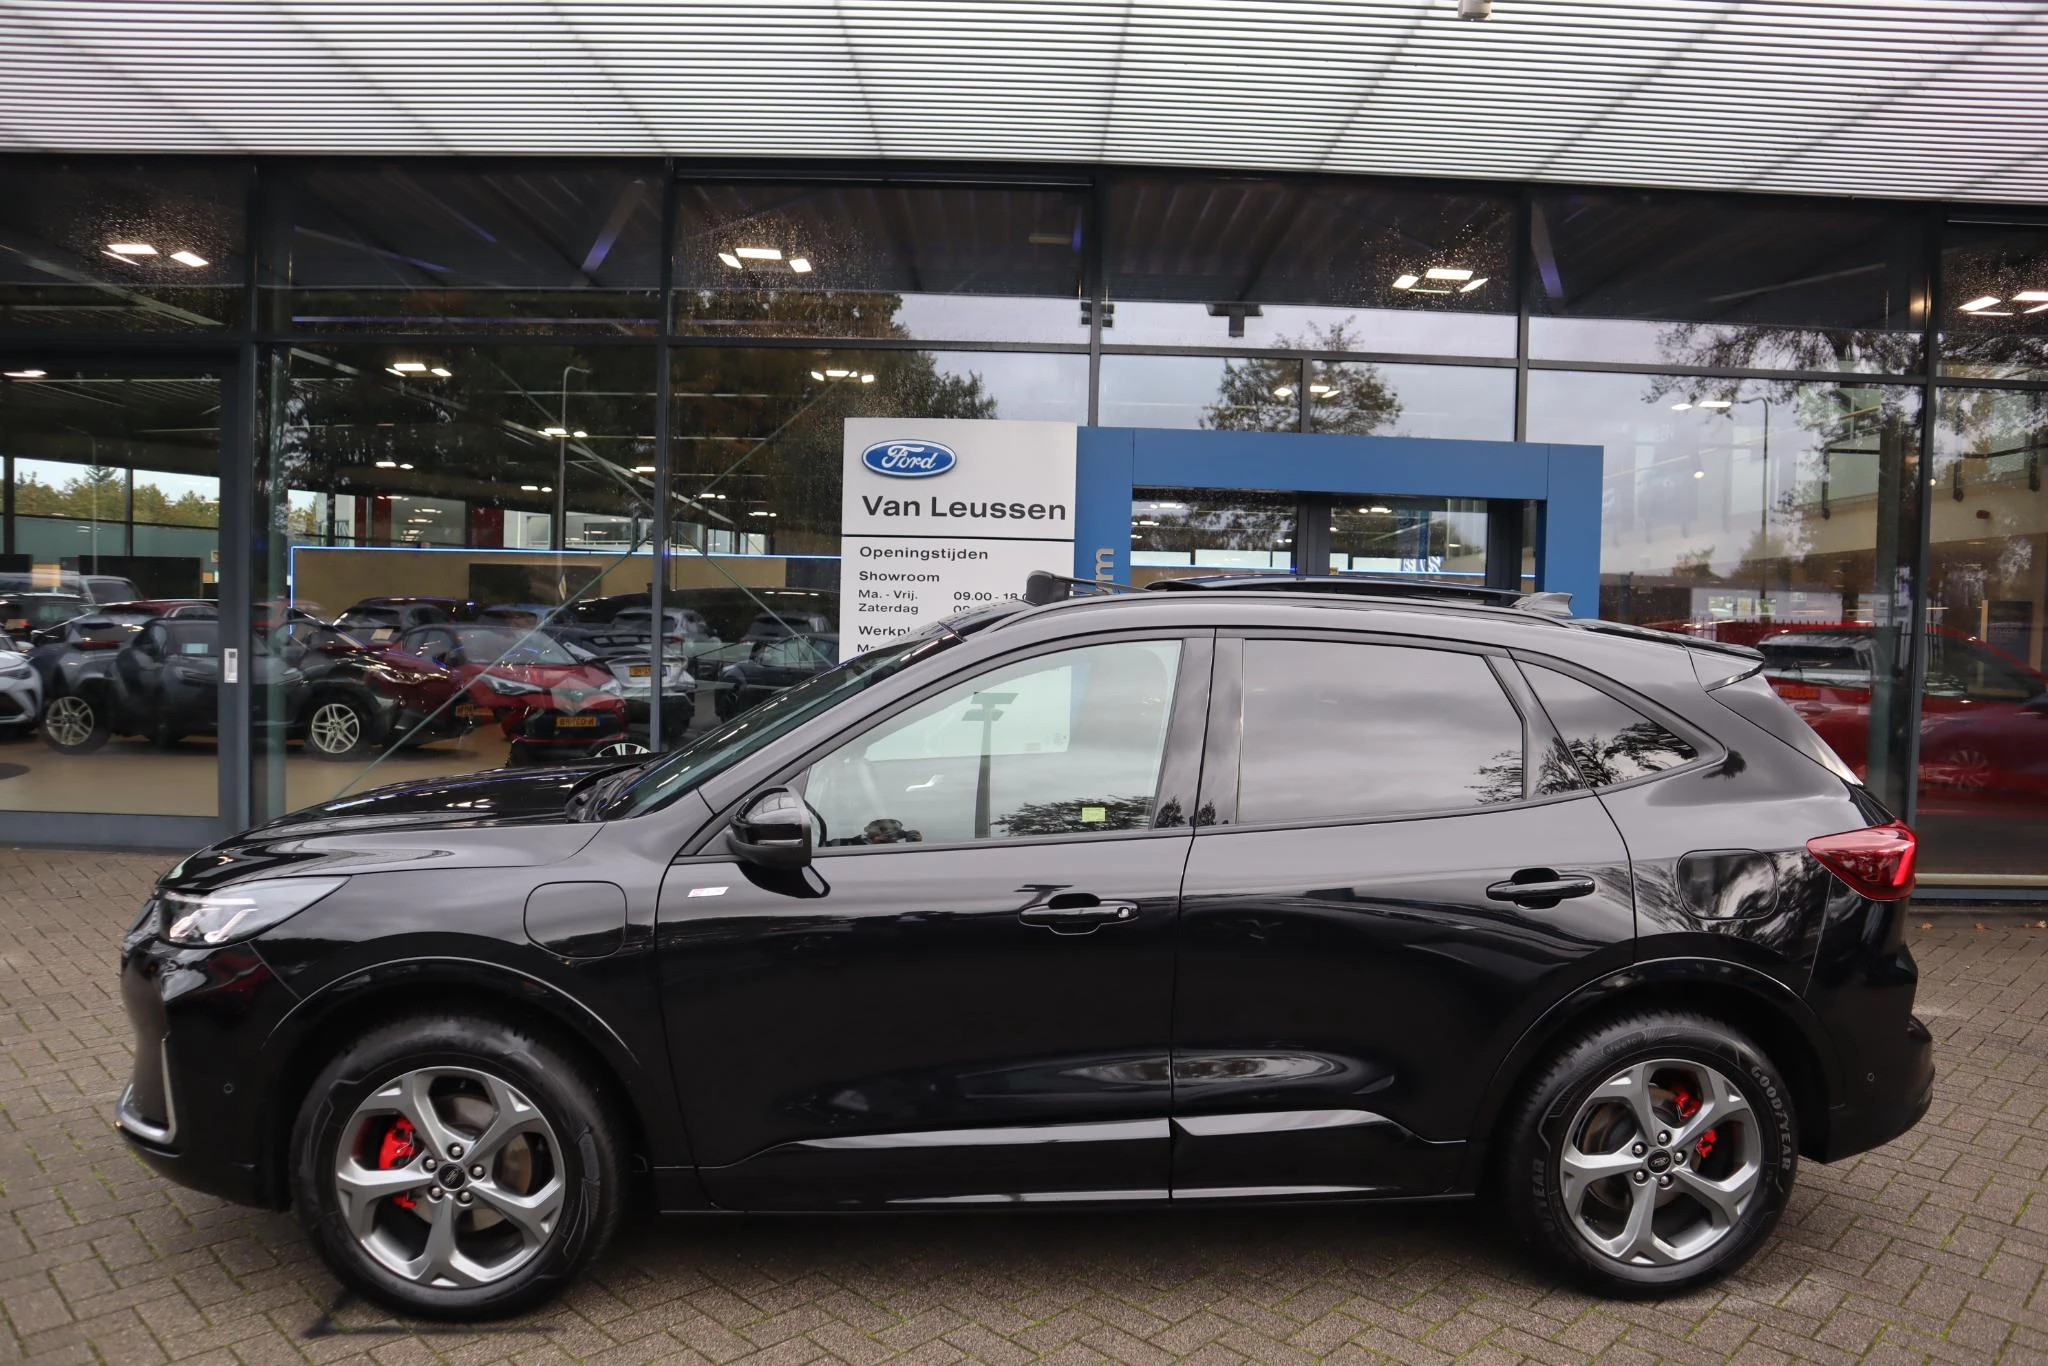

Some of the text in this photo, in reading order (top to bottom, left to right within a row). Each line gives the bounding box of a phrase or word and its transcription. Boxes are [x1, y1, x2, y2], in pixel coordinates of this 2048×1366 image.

[881, 445, 938, 469] Ford
[862, 495, 1066, 520] Van Leussen
[859, 546, 988, 561] Openingstijden
[858, 571, 940, 583] Showroom
[858, 589, 882, 599] Ma.
[893, 590, 919, 601] Vrij.
[953, 591, 993, 601] 09.00
[858, 603, 919, 615] Zaterdag
